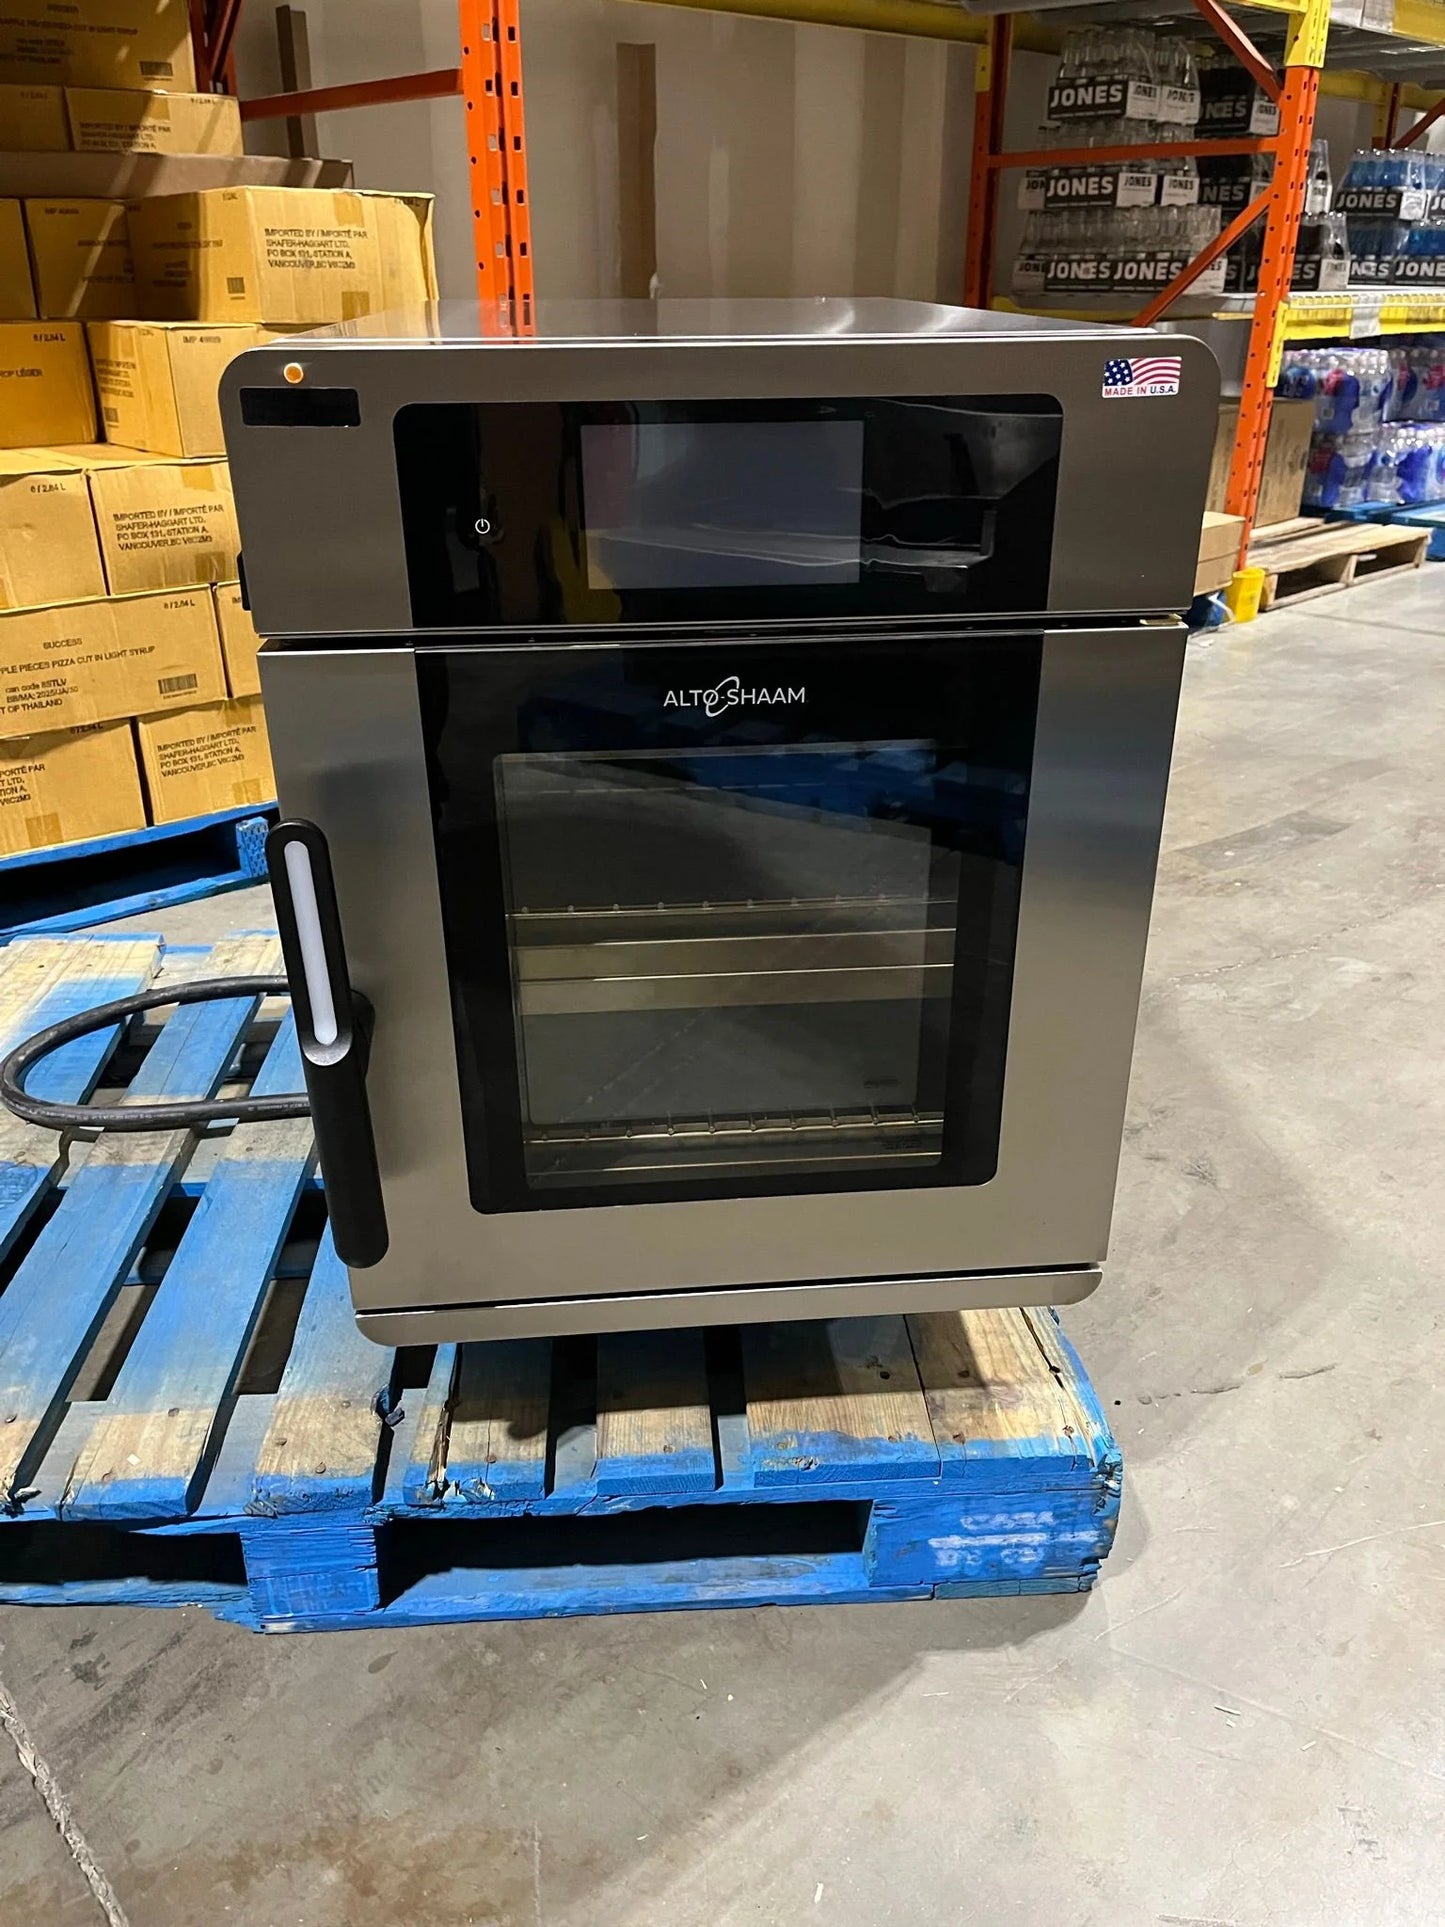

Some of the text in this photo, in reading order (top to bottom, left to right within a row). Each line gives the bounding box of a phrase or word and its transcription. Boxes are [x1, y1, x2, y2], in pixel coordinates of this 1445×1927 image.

[1051, 84, 1123, 108] JONES
[1200, 101, 1247, 119] NES
[1026, 177, 1114, 198] JON JONES
[1124, 176, 1152, 187] JONES
[1168, 179, 1194, 190] JONES
[1202, 184, 1245, 201] NES
[1336, 194, 1397, 208] JONES
[264, 228, 304, 237] IMPORTED
[305, 229, 315, 237] BY
[353, 231, 368, 239] PAR
[267, 249, 279, 257] PO
[280, 249, 297, 257] BOX
[313, 250, 344, 258] STATION
[1018, 261, 1183, 280] JON JONES JONES
[1350, 261, 1389, 277] NES
[1104, 385, 1176, 396] MADE IN U.S.A.
[60, 483, 66, 491] L
[112, 511, 156, 521] IMPORTED
[157, 509, 168, 518] BY
[173, 504, 208, 516] IMPORTÉ
[208, 504, 224, 513] PAR
[116, 532, 129, 541] PO
[131, 531, 149, 540] BOX
[166, 526, 200, 537] STATION
[43, 638, 82, 650] SUCCESS
[0, 646, 156, 674] PLE PIECES PIZZA CUT IN LIGHT SYRUP
[21, 683, 40, 691] code
[7, 704, 20, 713] OF
[20, 698, 63, 711] THAILAND
[157, 739, 195, 752] IMPORTED
[196, 736, 206, 744] BY
[210, 727, 241, 741] IMPORTÉ
[241, 725, 257, 735] PAR
[160, 761, 171, 769] PO
[172, 757, 188, 767] BOX
[204, 746, 233, 760] STATION
[28, 763, 45, 773] PAR
